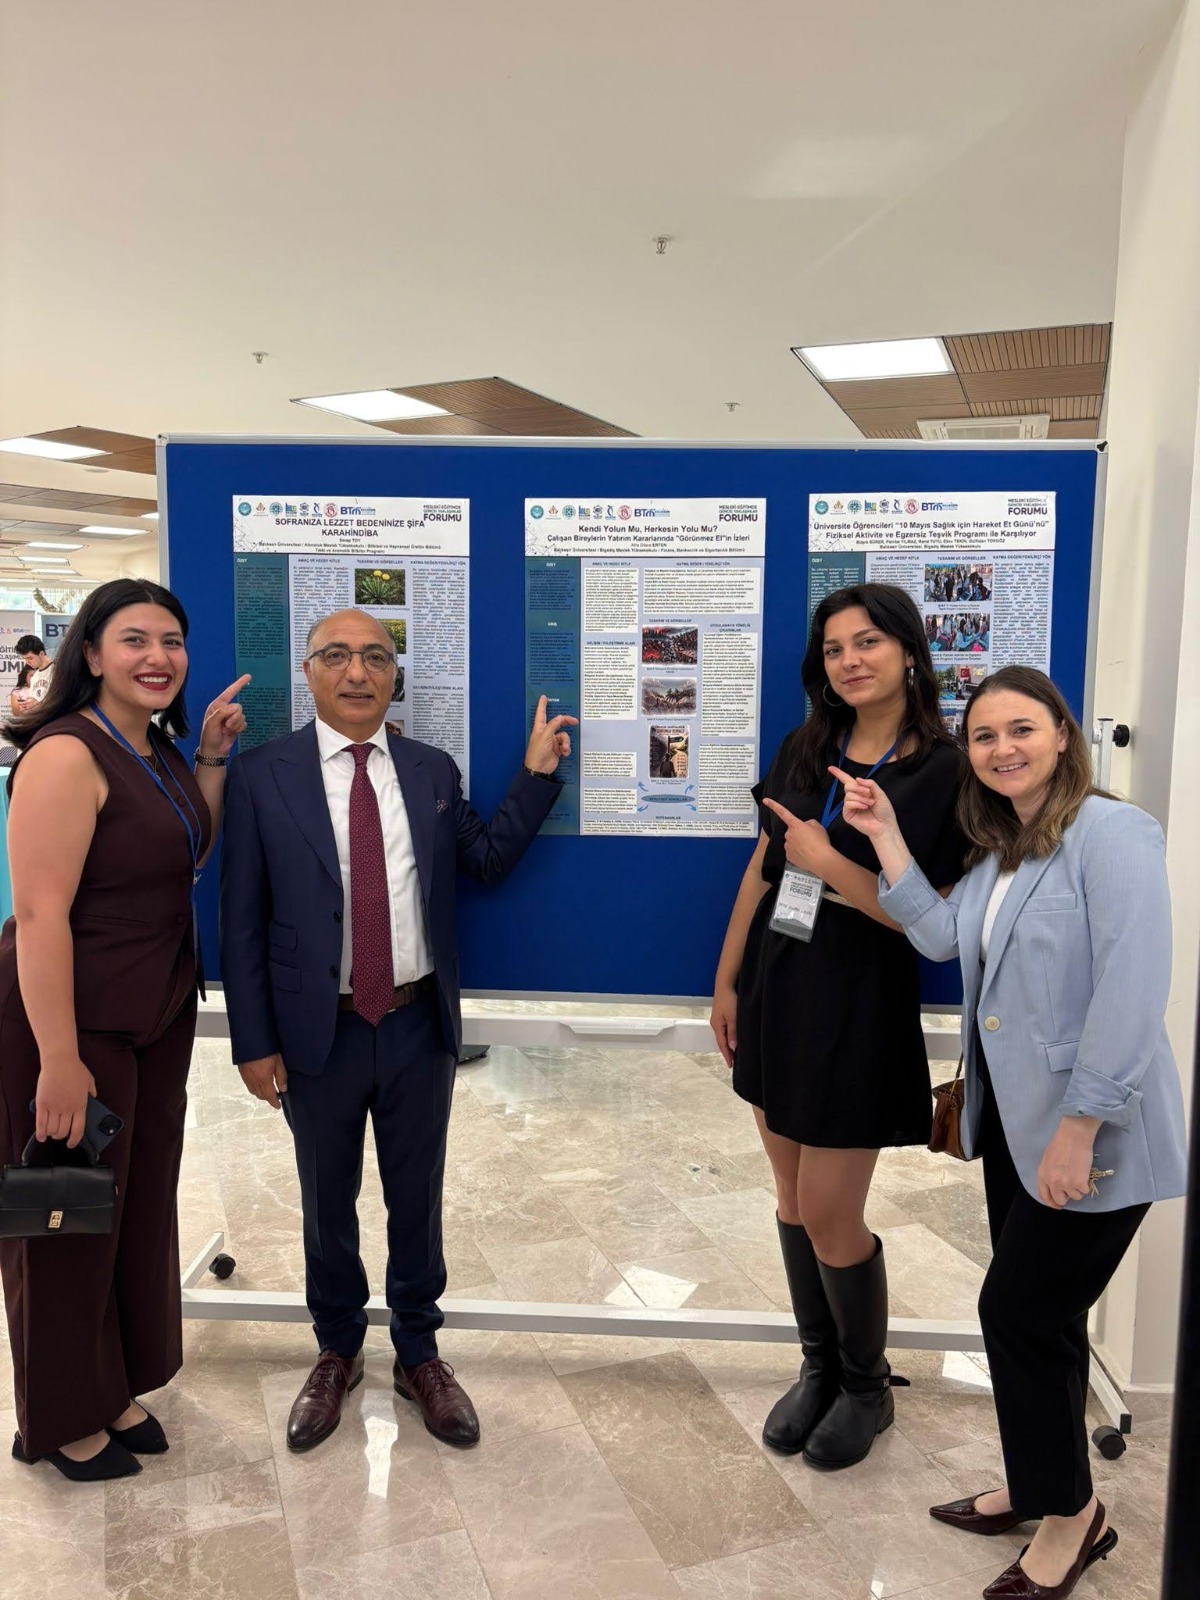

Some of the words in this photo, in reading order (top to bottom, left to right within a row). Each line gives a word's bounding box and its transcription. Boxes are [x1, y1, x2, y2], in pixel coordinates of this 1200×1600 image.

[1008, 507, 1048, 515] FORUMU
[357, 519, 404, 527] BEDENİNİZE
[407, 519, 425, 528] ŞİFA
[853, 522, 893, 530] Öğrencileri
[322, 528, 378, 536] KARAHİNDİBA
[790, 887, 812, 897] FORUMU
